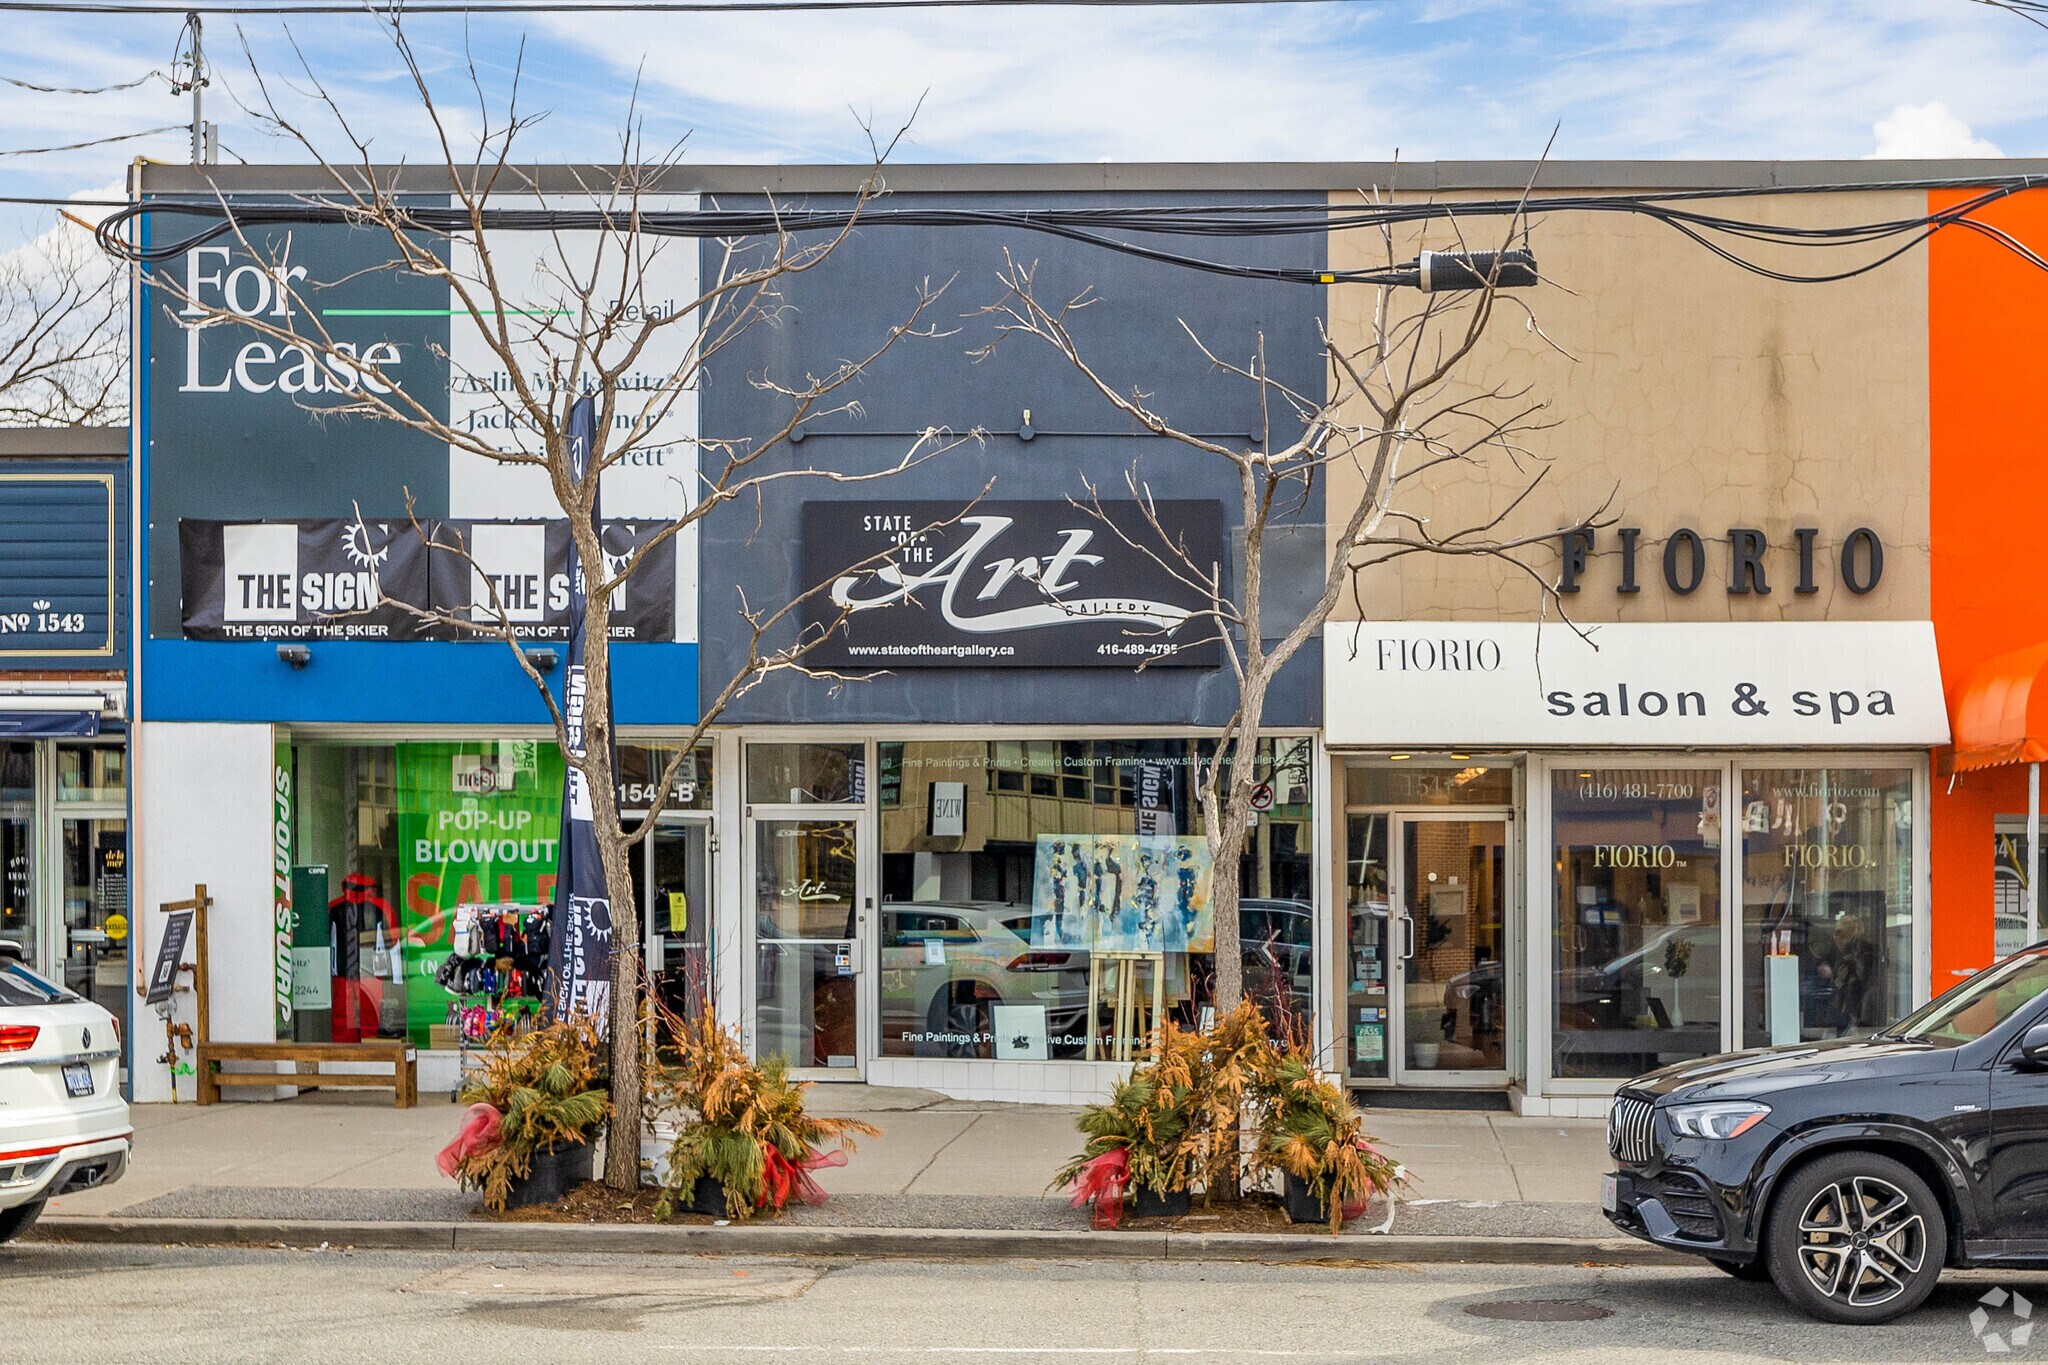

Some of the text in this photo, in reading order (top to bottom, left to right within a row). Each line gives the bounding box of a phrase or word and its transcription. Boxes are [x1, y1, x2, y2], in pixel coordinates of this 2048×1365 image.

[178, 247, 308, 317] For
[178, 323, 402, 394] Lease
[863, 515, 912, 531] STATE
[902, 547, 933, 563] THE
[1557, 528, 1884, 596] FIORIO
[238, 572, 379, 611] THE SIGN
[486, 574, 538, 610] THE
[548, 572, 628, 612] SN
[37, 613, 85, 632] 1543
[222, 625, 389, 637] THE SIGN OF THE SKIER
[504, 626, 535, 637] IGN
[537, 626, 558, 637] OF
[848, 643, 1178, 658] www.stateoftheartgallery.ca 416-489-4795
[1375, 638, 1502, 672] FIORIO
[1547, 682, 1895, 724] salon & spa
[902, 757, 923, 767] Fine
[926, 757, 970, 769] Paintings
[972, 758, 980, 767] &
[983, 757, 1011, 767] Prints
[1020, 757, 1061, 767] Creative
[1064, 756, 1103, 767] Custom
[1105, 756, 1146, 769] Framing
[618, 783, 694, 803] 154-B
[1579, 783, 1693, 801] (416) 481-7700
[1771, 784, 1881, 798] www.fiorio.com
[439, 810, 532, 831] POP-UP
[415, 838, 558, 863] BLOWOUT
[1593, 844, 1676, 868] FIORIO
[1783, 844, 1866, 868] FIORIO
[275, 765, 294, 1023] SPORT SWAP
[407, 872, 558, 945] SA
[902, 1031, 924, 1041] Fine
[926, 1031, 971, 1044] Paintings
[973, 1033, 980, 1042] &
[1064, 1034, 1103, 1045] Custm
[1359, 1028, 1379, 1036] PASS
